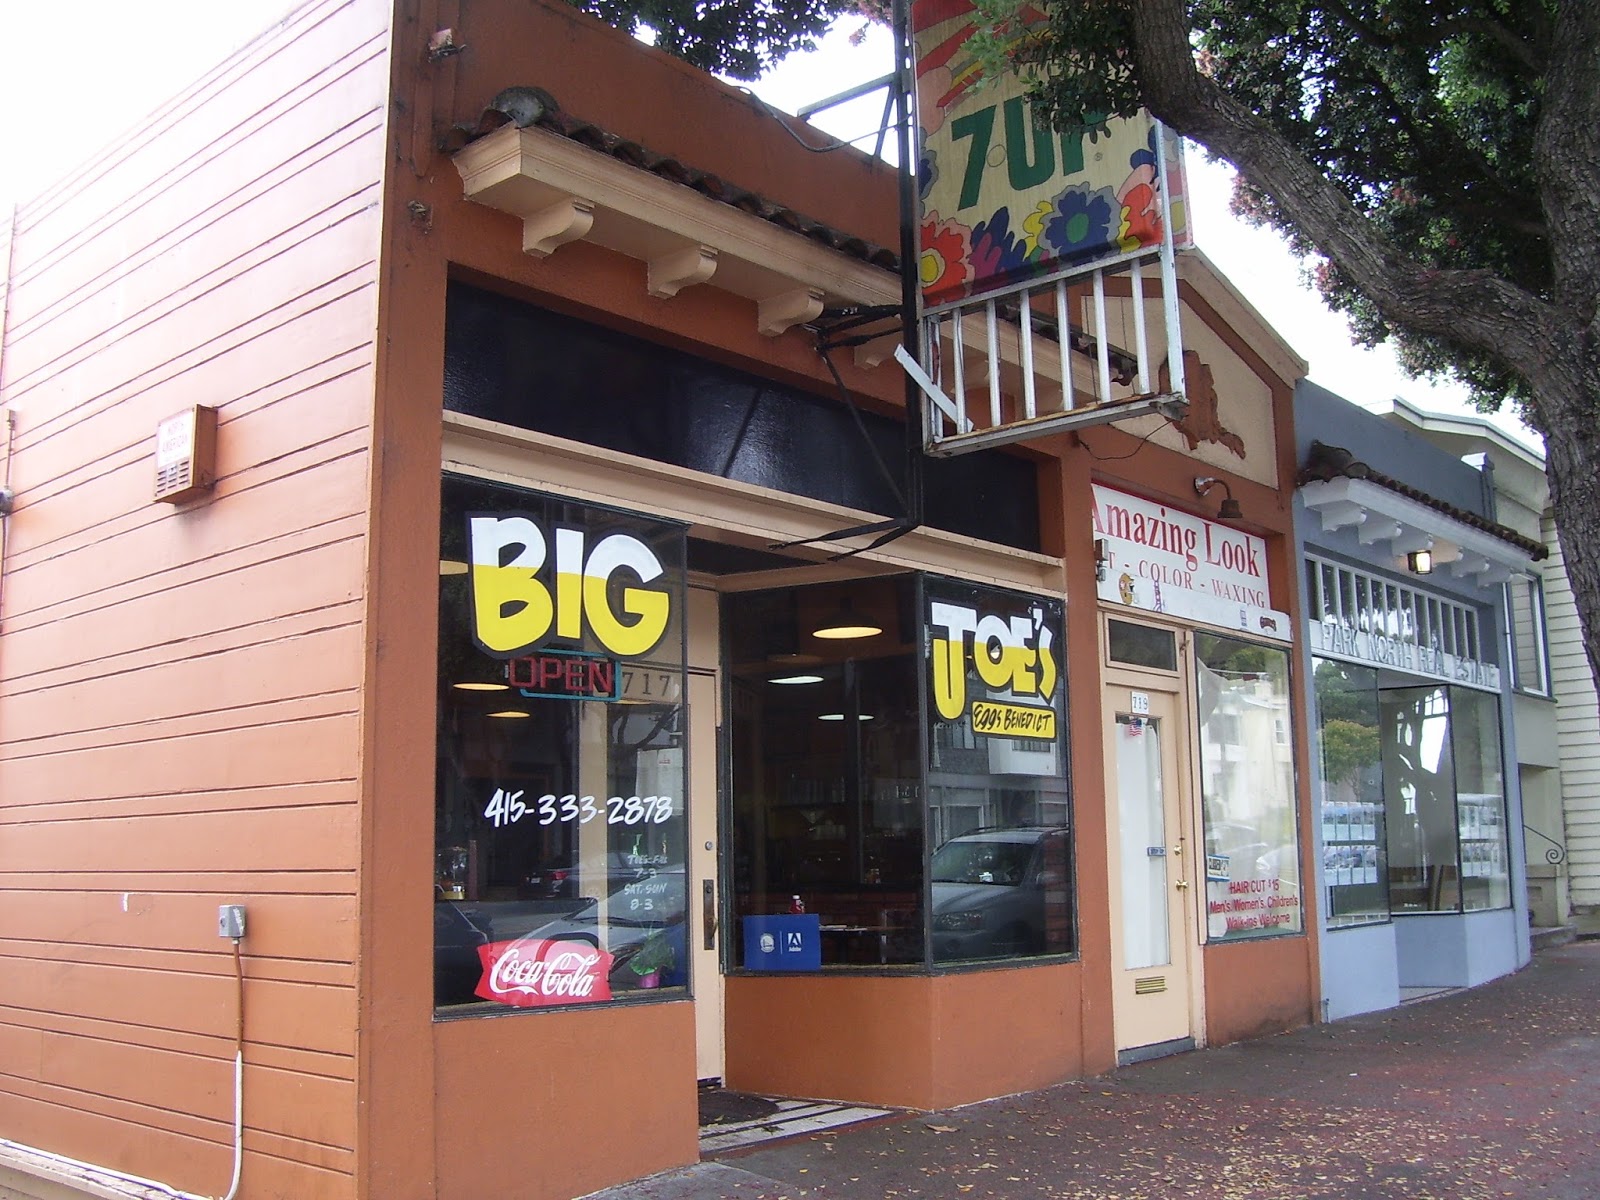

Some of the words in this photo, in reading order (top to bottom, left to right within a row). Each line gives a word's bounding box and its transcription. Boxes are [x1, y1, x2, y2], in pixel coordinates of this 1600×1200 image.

[1092, 496, 1198, 571] Amazing
[1203, 520, 1261, 578] Look
[471, 517, 669, 655] BIG
[1139, 559, 1194, 590] COLOR
[1211, 578, 1265, 609] WAXING
[1321, 621, 1359, 656] PARK
[509, 656, 613, 692] OPEN
[931, 602, 1057, 719] JOE'S
[622, 672, 671, 697] 717
[1003, 708, 1052, 732] BENEDICT
[1132, 696, 1148, 710] 719
[484, 788, 673, 827] 415-333-2878
[1229, 881, 1249, 894] HAIR
[1251, 879, 1266, 893] CUT
